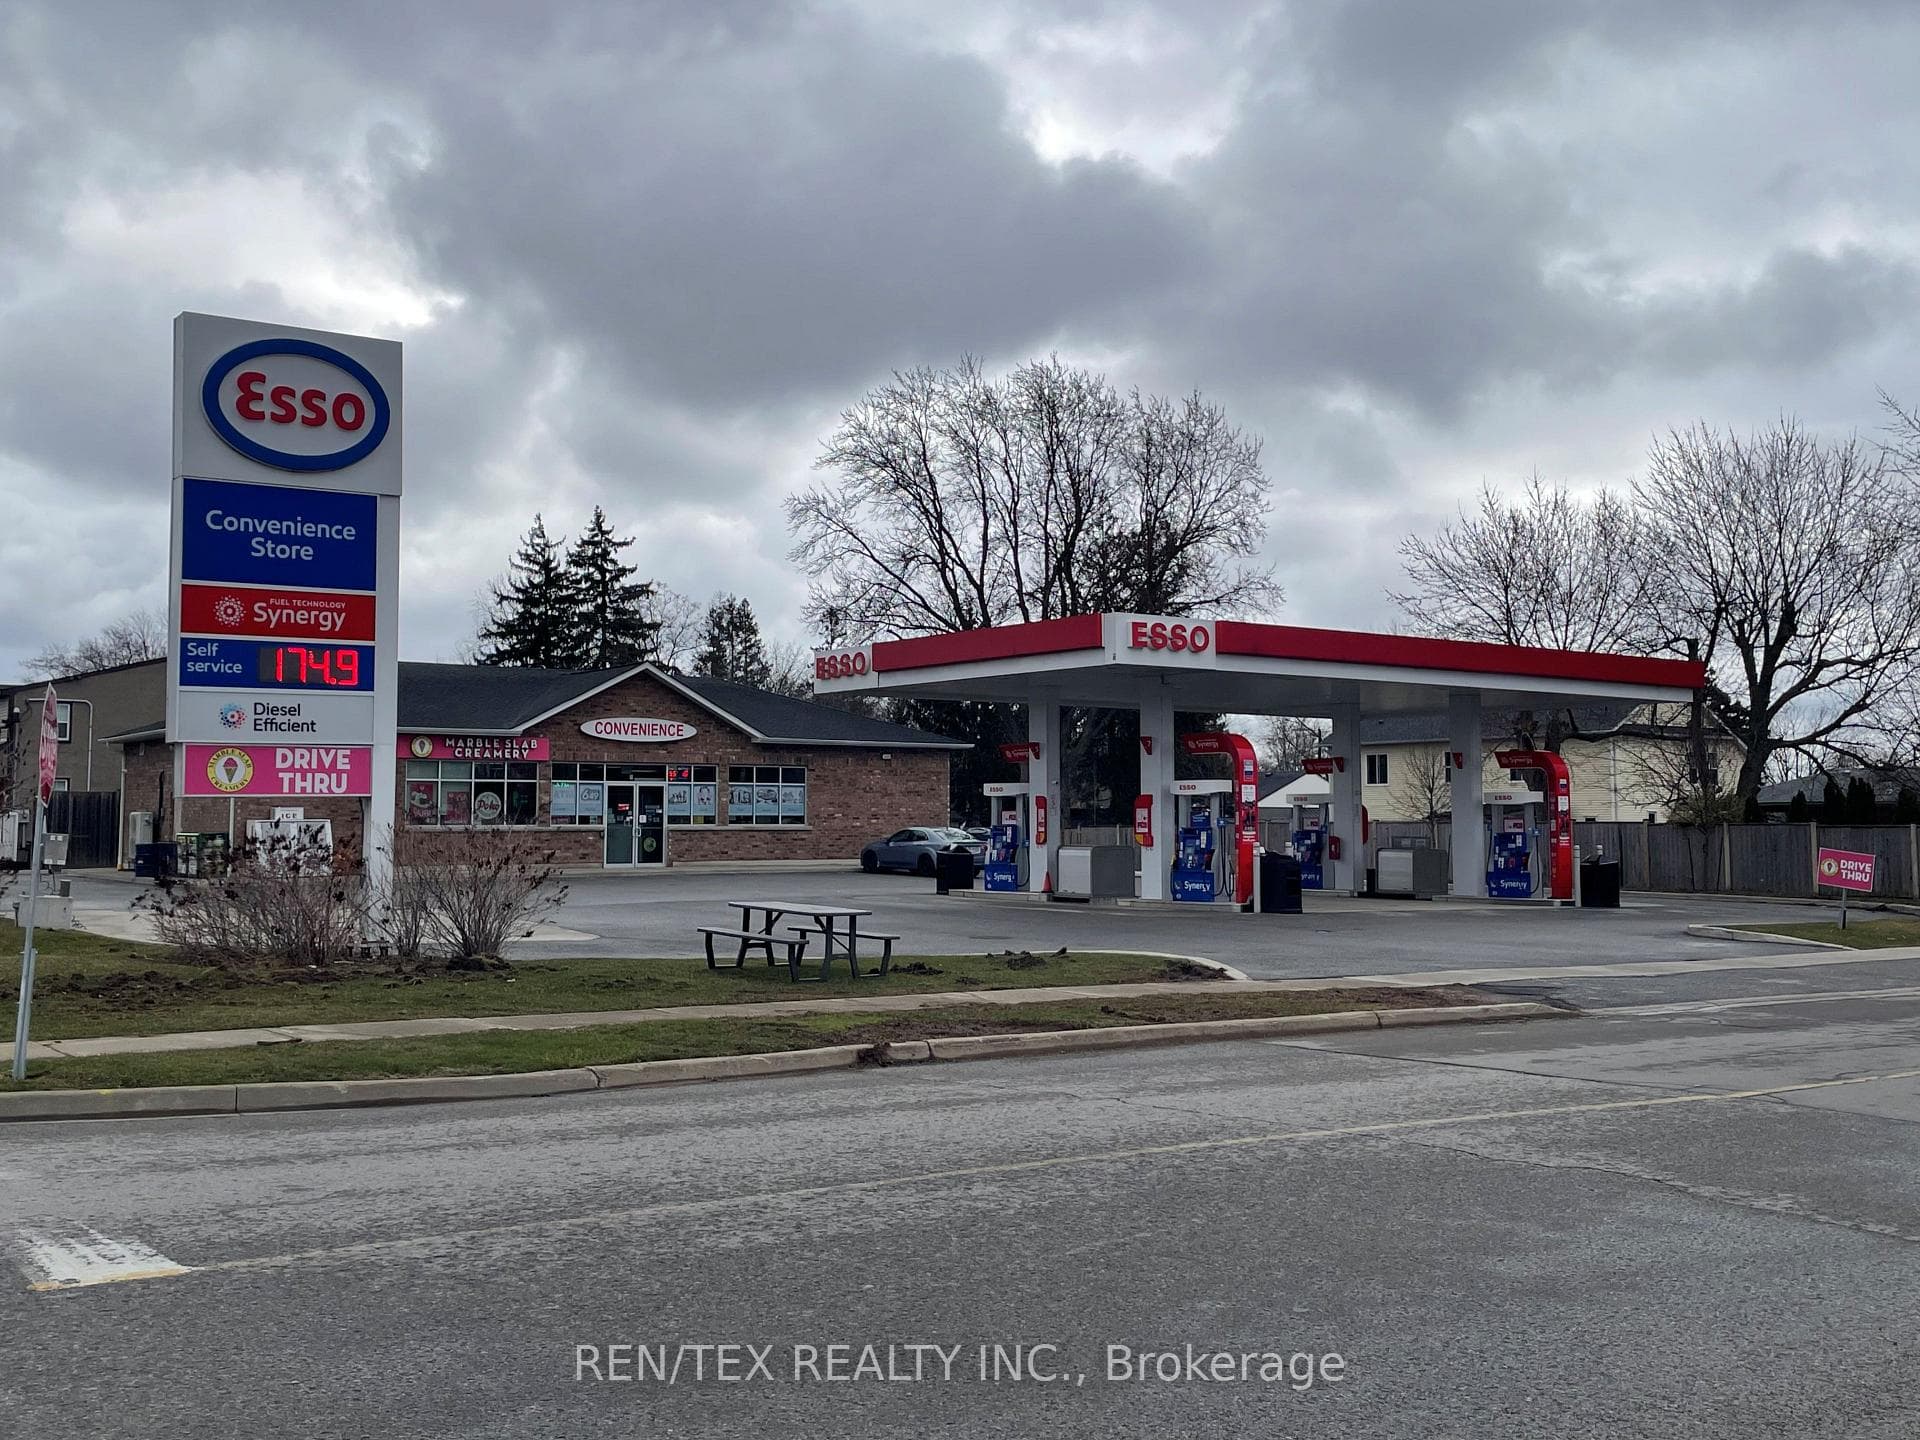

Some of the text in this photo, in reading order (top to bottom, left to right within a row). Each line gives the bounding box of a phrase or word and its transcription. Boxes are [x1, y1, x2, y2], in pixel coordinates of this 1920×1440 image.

[235, 371, 366, 431] Esso
[205, 510, 356, 540] Convenience
[251, 537, 314, 561] Store
[269, 598, 346, 609] FUEL TECHNOLOGY
[253, 602, 346, 631] Synergy
[1130, 621, 1211, 653] ESSO
[187, 642, 219, 656] Self
[187, 659, 243, 674] service
[275, 647, 359, 686] 174.9
[816, 651, 870, 680] ESSO
[253, 702, 301, 717] Diesel
[253, 718, 317, 733] Efficient
[595, 721, 684, 737] CONVENIENCE
[445, 737, 538, 749] MARBLE SLAB
[275, 748, 351, 770] DRIVE
[454, 747, 529, 759] CREAMERY
[278, 772, 349, 794] THRU
[1840, 859, 1872, 872] DRIVE
[1841, 869, 1870, 882] THRU
